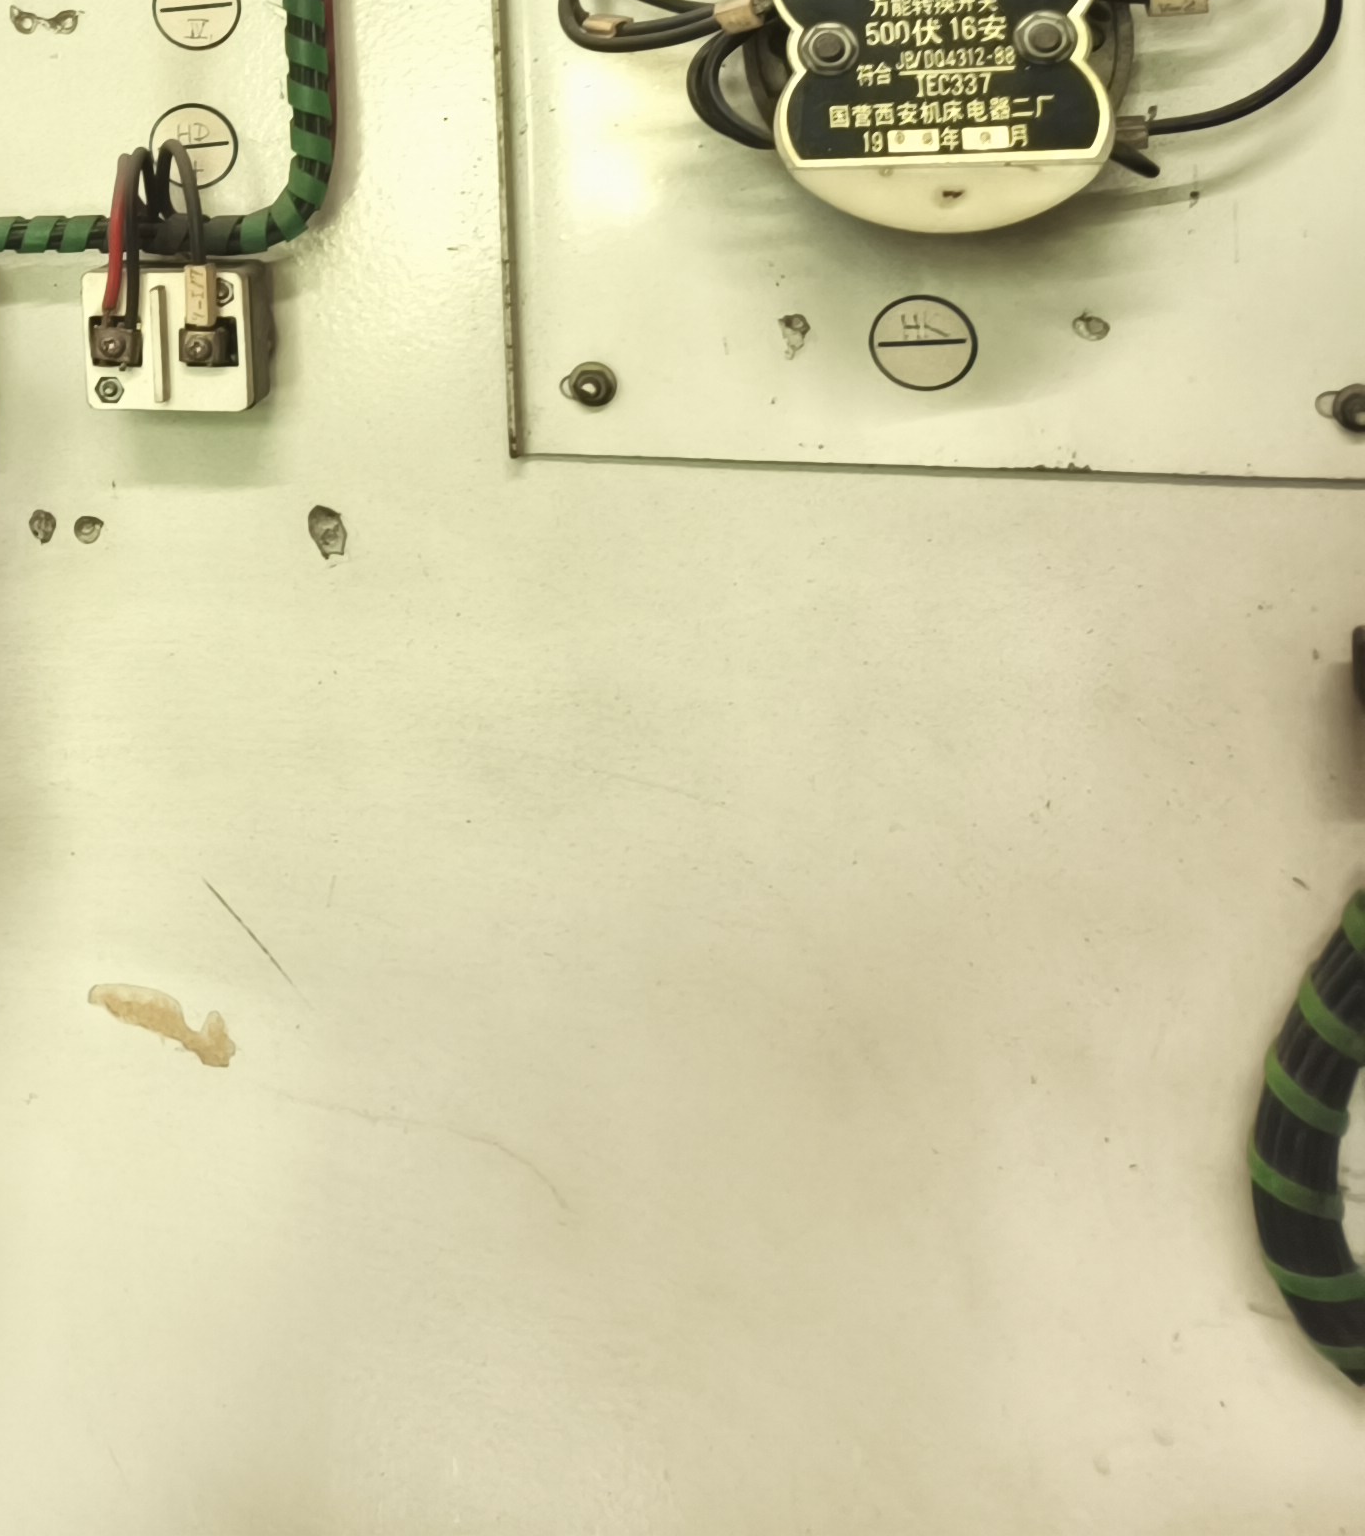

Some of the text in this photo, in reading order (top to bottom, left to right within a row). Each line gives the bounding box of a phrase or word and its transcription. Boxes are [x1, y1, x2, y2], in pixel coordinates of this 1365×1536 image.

[856, 62, 892, 87] 符合
[915, 72, 992, 98] IEC337
[828, 94, 1056, 129] 国营西安机床电器二厂
